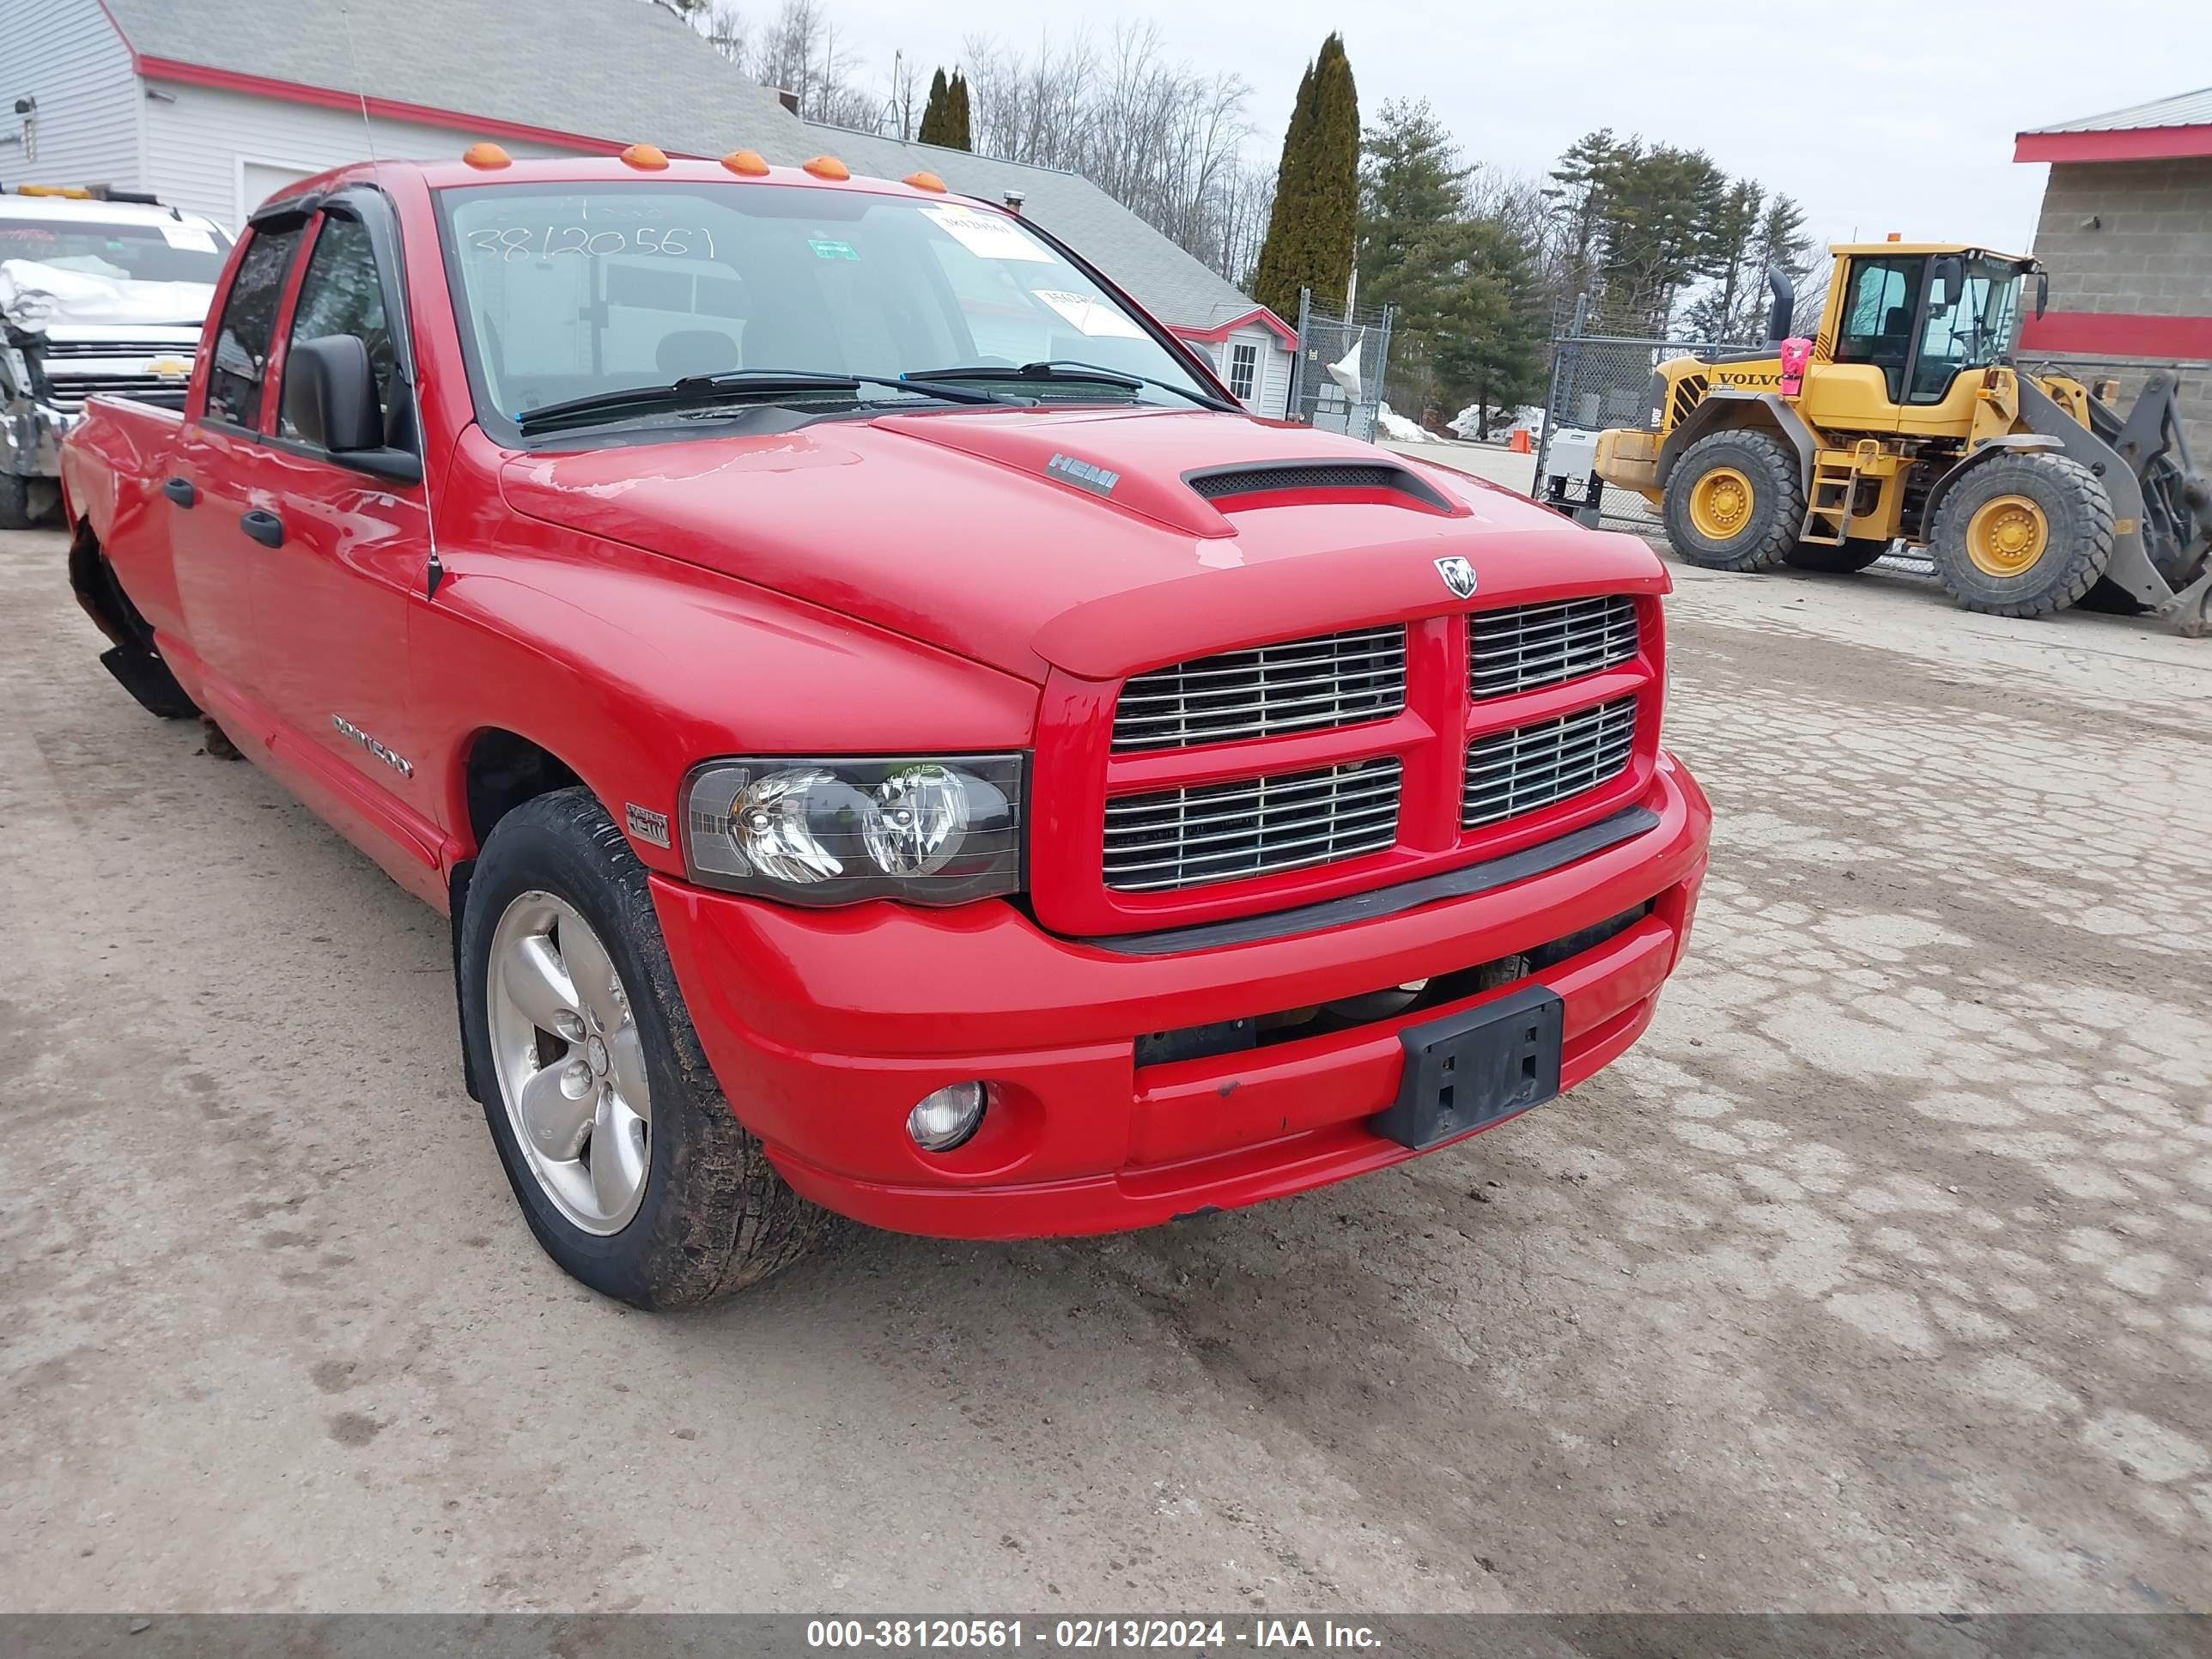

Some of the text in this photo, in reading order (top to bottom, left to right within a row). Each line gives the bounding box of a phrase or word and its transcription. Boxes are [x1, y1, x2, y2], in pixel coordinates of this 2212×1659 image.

[467, 226, 714, 261] 38120561
[1650, 407, 1662, 428] L90F
[1047, 453, 1121, 489] HEMI
